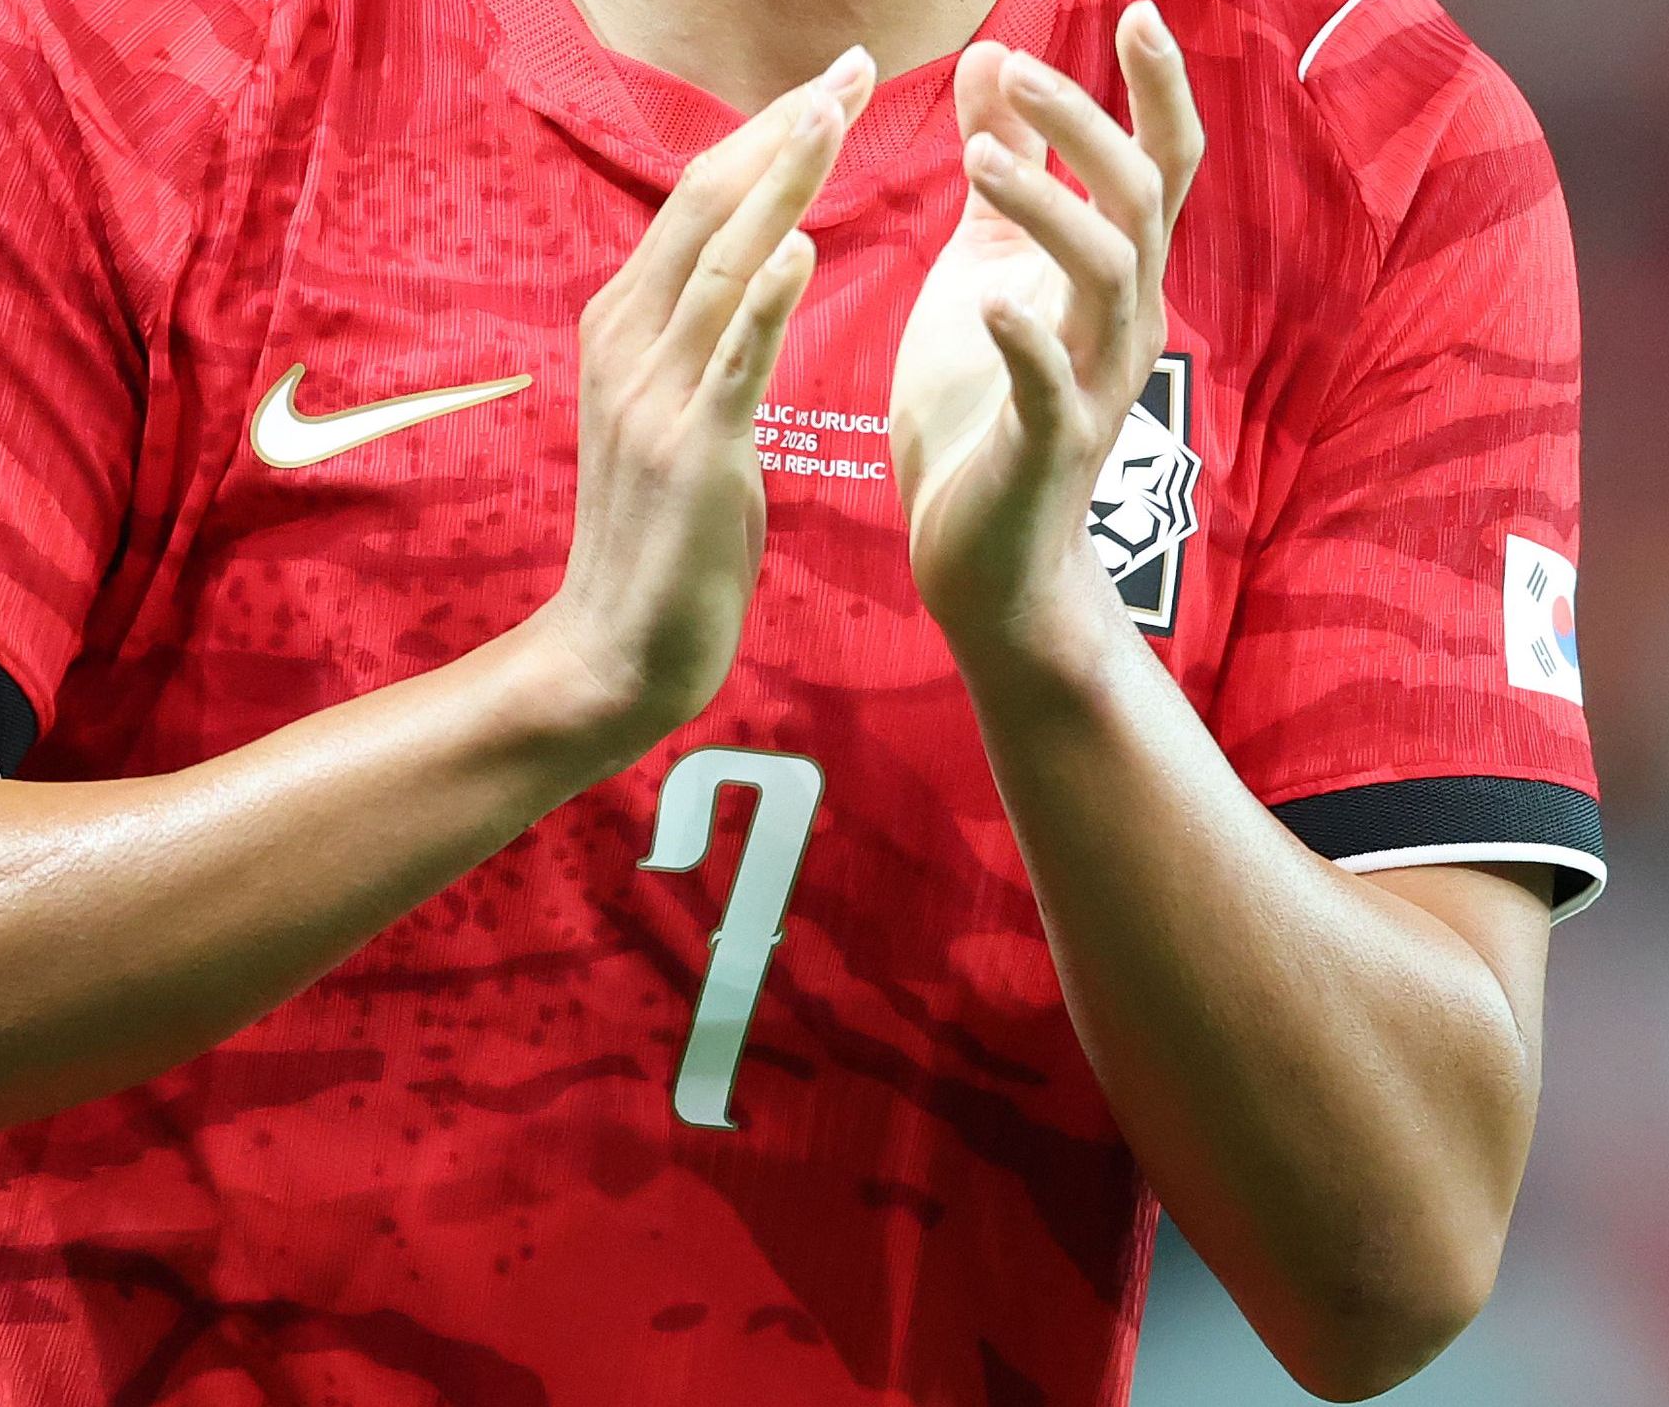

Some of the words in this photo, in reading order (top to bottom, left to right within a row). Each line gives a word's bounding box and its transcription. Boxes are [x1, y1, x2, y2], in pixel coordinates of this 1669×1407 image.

[810, 409, 890, 435] URUGU
[780, 429, 818, 452] 2026
[785, 454, 886, 480] REPUBLIC
[636, 745, 826, 1131] 7
